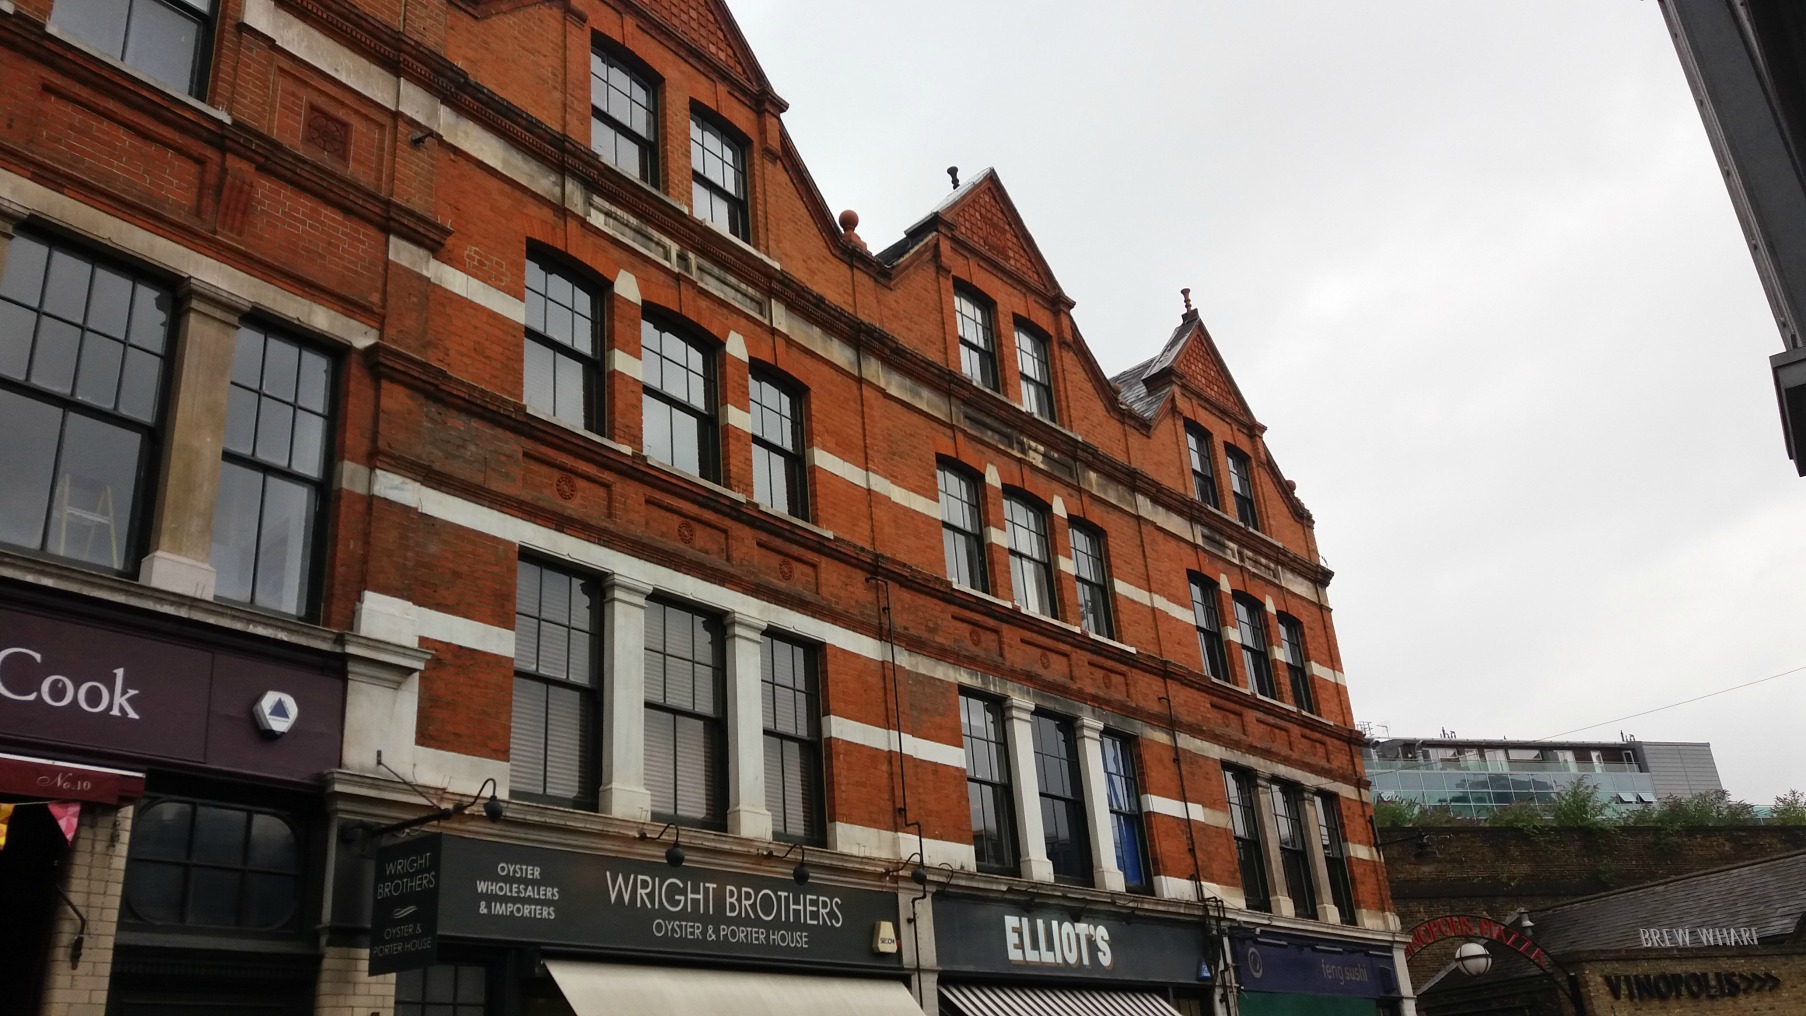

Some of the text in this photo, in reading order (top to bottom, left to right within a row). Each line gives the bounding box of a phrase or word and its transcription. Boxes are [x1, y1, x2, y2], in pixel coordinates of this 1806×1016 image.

[0, 647, 140, 719] Cook
[385, 852, 431, 876] WRIGHT
[498, 863, 541, 880] OYSTER
[377, 871, 435, 899] BROTHERS
[477, 880, 560, 901] WHOLESALERS
[479, 901, 555, 920] & IMPORTERS
[606, 871, 843, 928] WRIGHT BROTHERS
[384, 922, 421, 940] OYSTER &
[652, 919, 809, 948] OYSTER & PORTER HOUSE
[1004, 915, 1113, 970] ELLIOT'S
[1405, 915, 1545, 968] INOPOLIS PIAZZA
[1639, 927, 1759, 947] BREW WHARF
[373, 936, 432, 957] PORTER HOUSE
[1321, 959, 1369, 985] feng sushi
